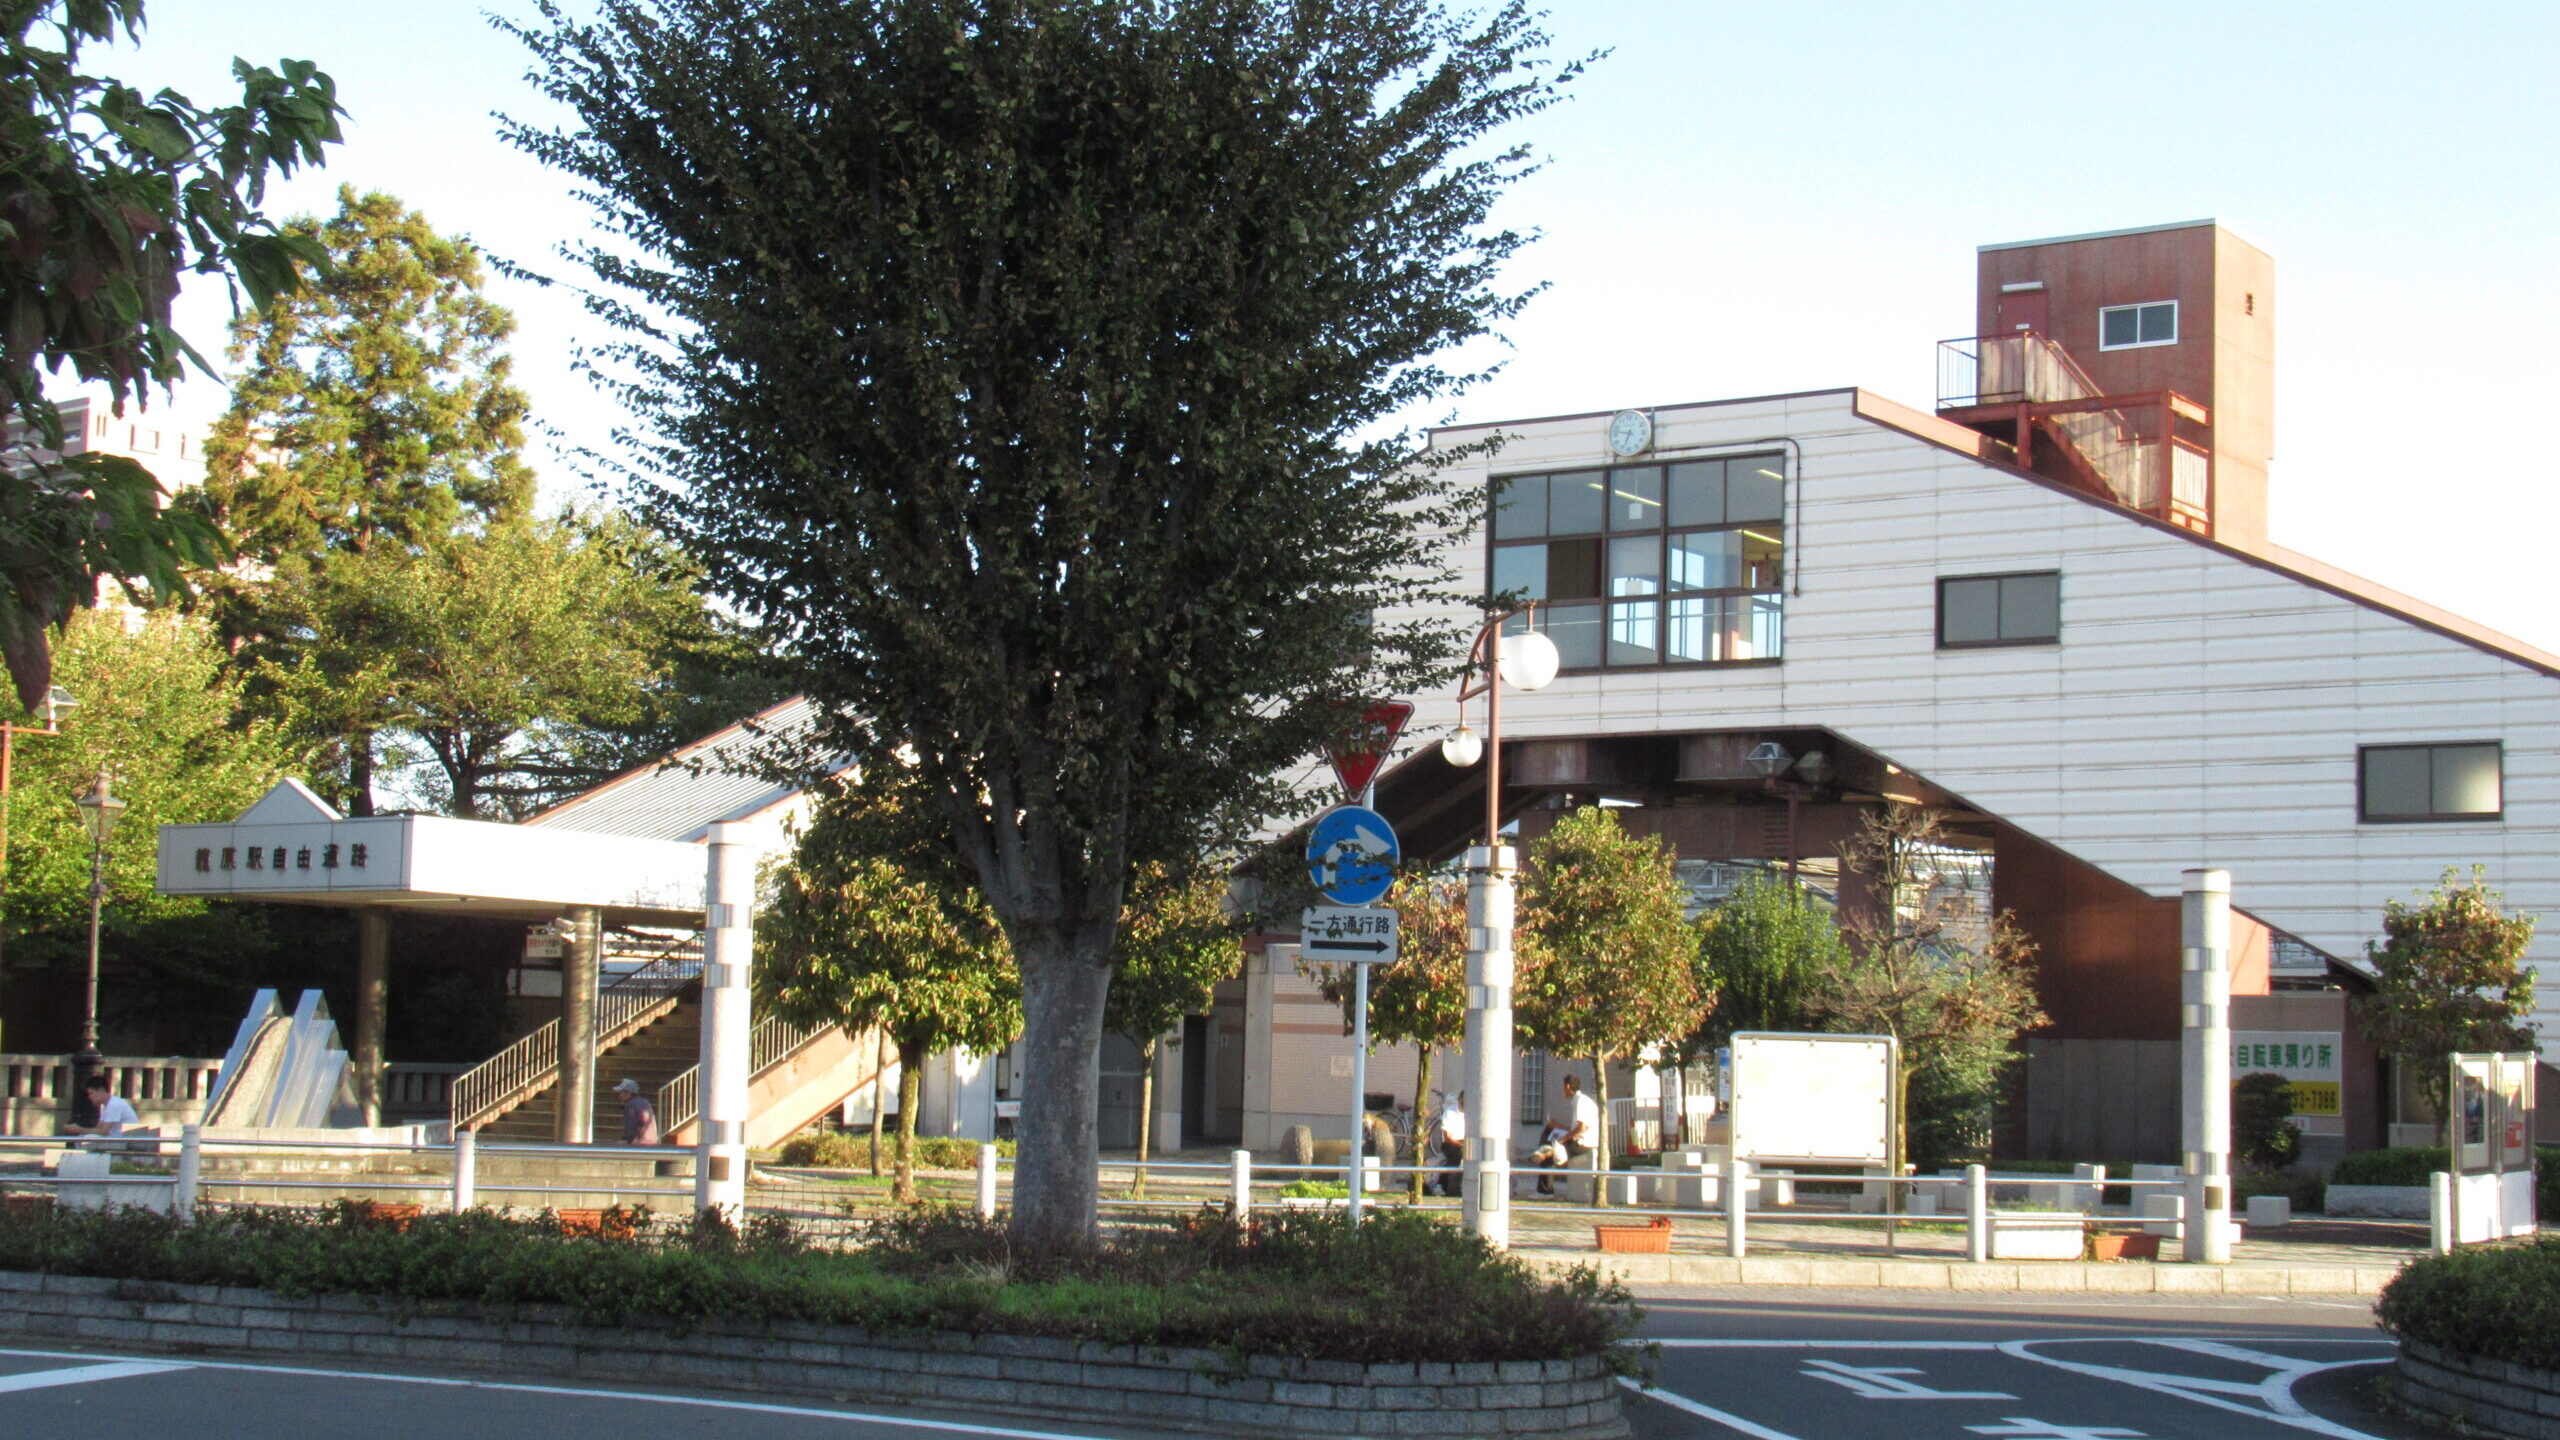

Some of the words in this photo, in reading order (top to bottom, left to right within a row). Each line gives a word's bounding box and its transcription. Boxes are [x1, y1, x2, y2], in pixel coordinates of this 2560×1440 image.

[1310, 914, 1390, 934] 一方通行路
[2229, 1044, 2332, 1069] 自転車預り所
